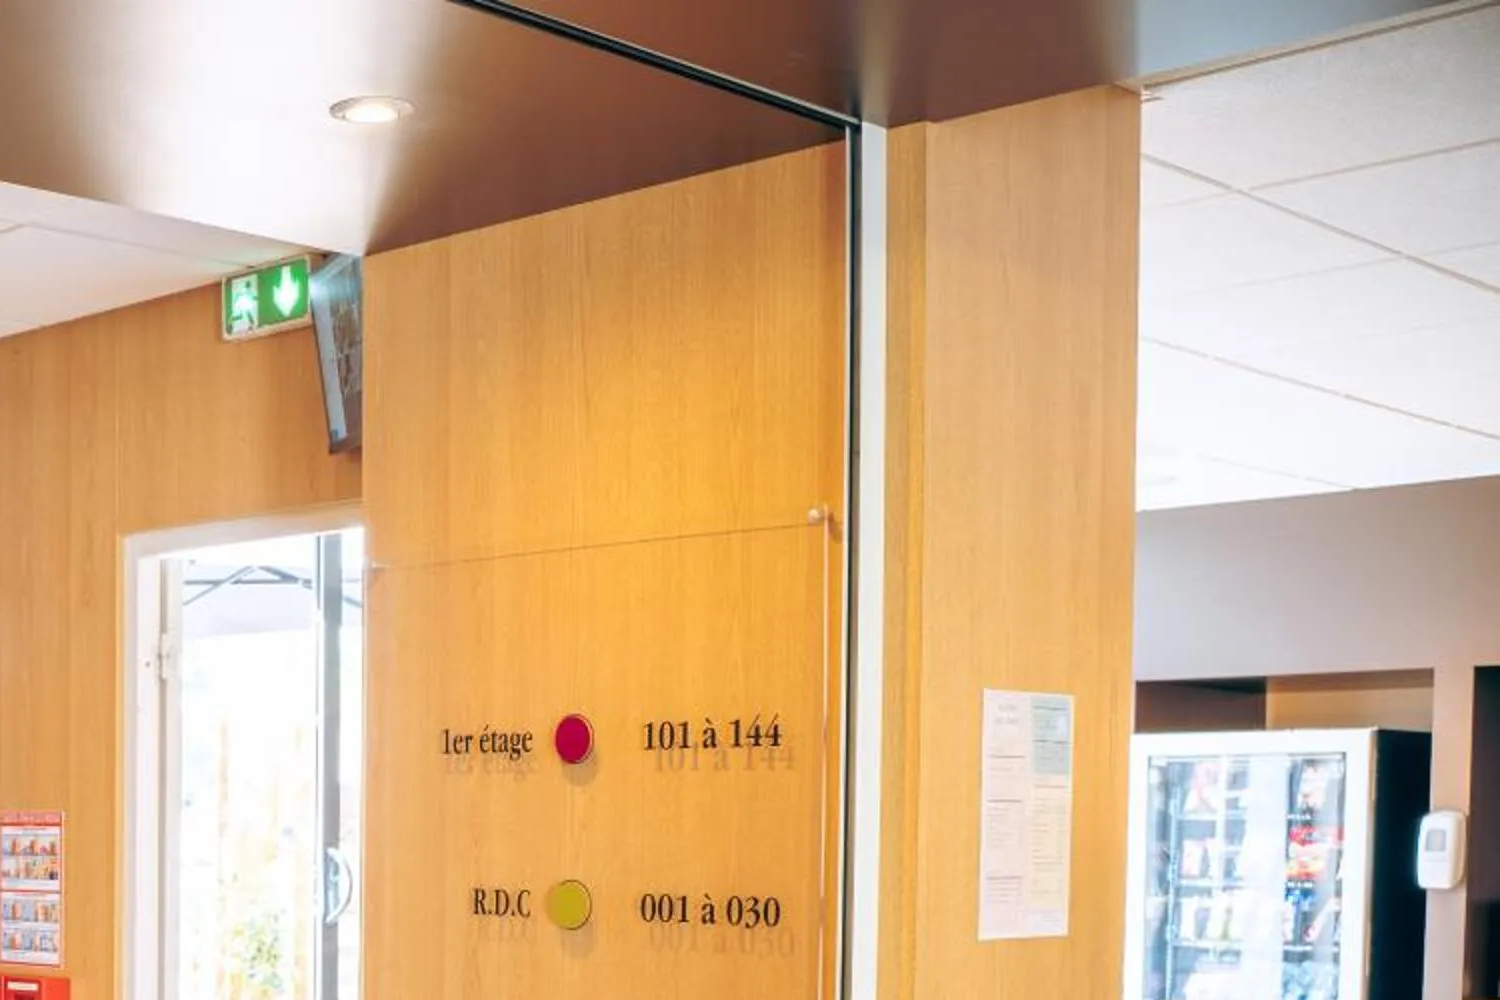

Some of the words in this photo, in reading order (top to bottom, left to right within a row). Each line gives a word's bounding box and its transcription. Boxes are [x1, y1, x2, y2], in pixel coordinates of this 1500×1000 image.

[442, 728, 473, 755] 1er
[479, 724, 533, 761] étage
[644, 720, 690, 751] 101
[703, 717, 717, 748] à
[729, 712, 782, 748] 144
[473, 888, 531, 918] R.D.C
[640, 893, 689, 923] 001
[701, 892, 716, 925] à
[726, 895, 781, 929] 030
